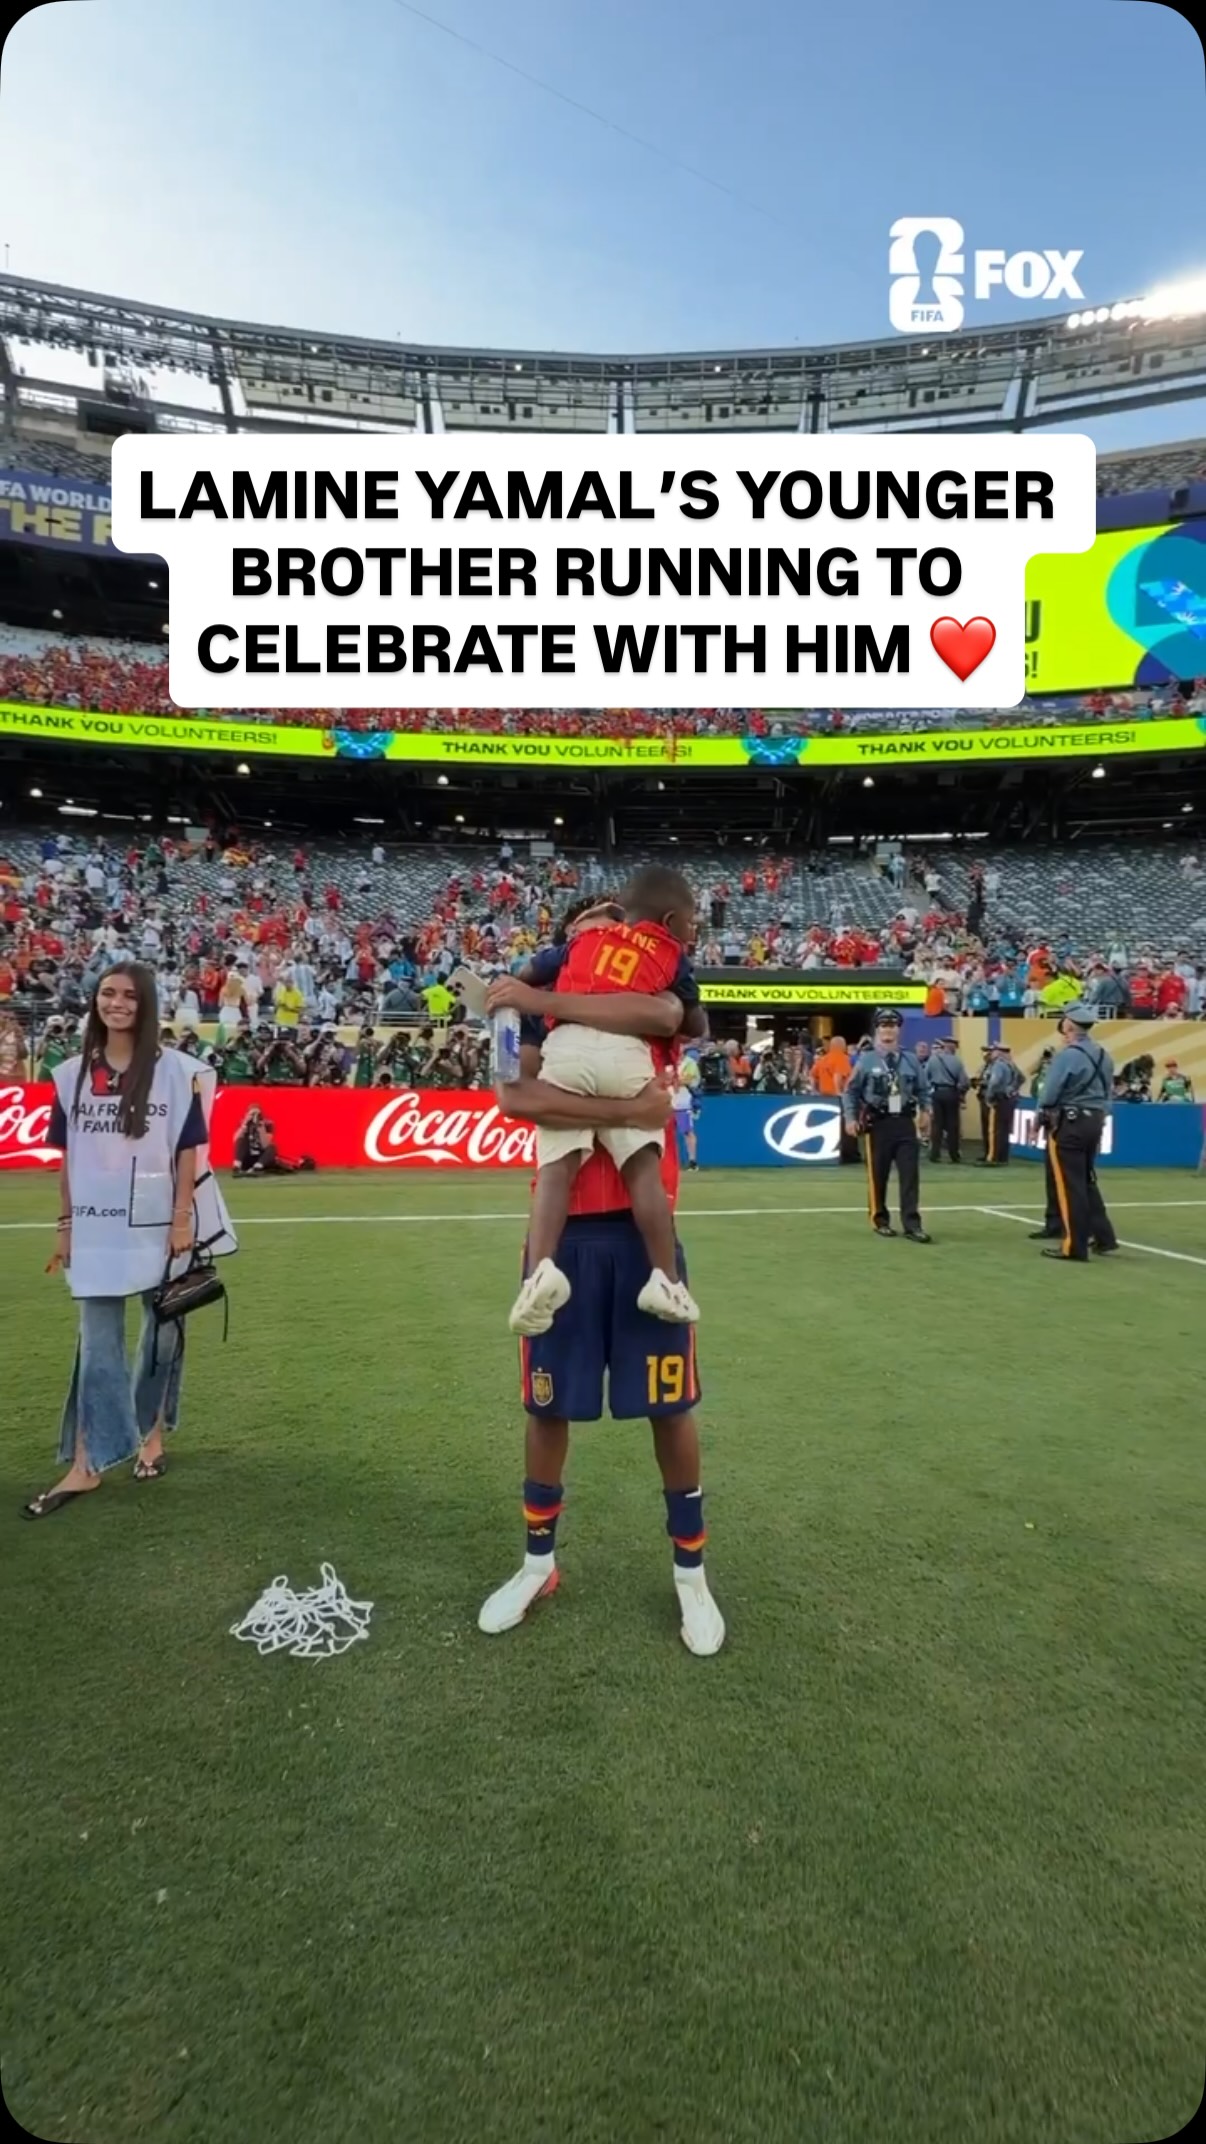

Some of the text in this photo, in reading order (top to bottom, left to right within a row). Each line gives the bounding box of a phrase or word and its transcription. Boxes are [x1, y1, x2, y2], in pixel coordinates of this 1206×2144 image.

[0, 711, 278, 745] THANK YOU VOLUNTEERS!
[442, 741, 508, 755] THANK
[512, 744, 550, 756] YOU
[858, 731, 1136, 756] THANK YOU VOLUNTEERS!
[594, 944, 640, 986] 19
[704, 988, 910, 1001] THANK YOU VOLUNTEERS!
[647, 1355, 685, 1405] 19
